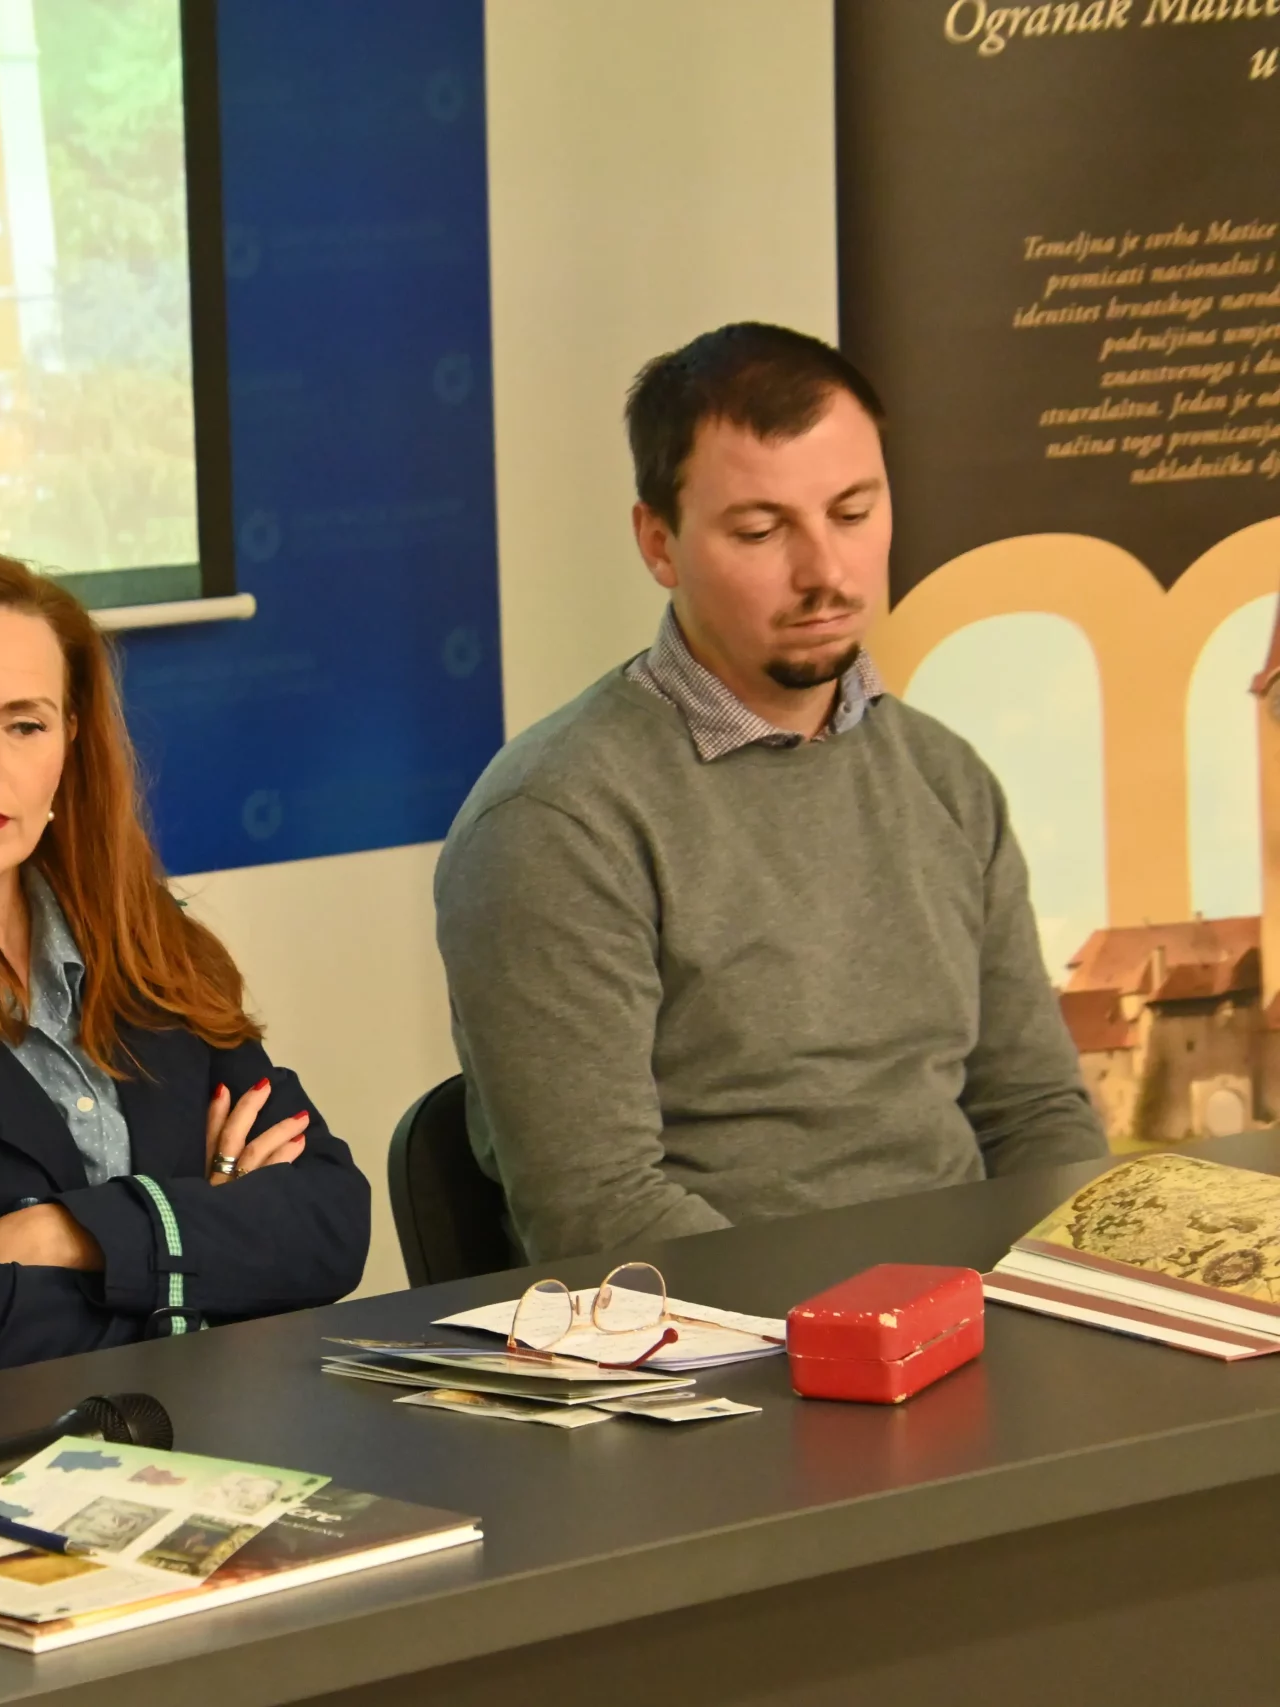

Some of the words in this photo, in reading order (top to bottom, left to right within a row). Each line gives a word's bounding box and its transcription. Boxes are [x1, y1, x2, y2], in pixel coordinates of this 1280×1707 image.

[944, 0, 1131, 57] Ogranak
[1249, 46, 1280, 80] u
[1023, 230, 1116, 262] Temeljna
[1117, 228, 1141, 258] je
[1144, 222, 1201, 251] svrha
[1203, 218, 1278, 245] Matice
[1042, 262, 1147, 300] promicati
[1150, 252, 1261, 283] nacionalni
[1263, 253, 1275, 274] i
[1012, 303, 1103, 329] identitet
[1105, 291, 1214, 322] hrvatskoga
[1097, 326, 1219, 363] područjima
[1099, 359, 1236, 388] znanstvenoga
[1239, 354, 1251, 376] i
[1167, 388, 1228, 422] Jedan
[1228, 387, 1253, 418] je
[1045, 434, 1116, 458] načina
[1121, 432, 1164, 458] toga
[1130, 452, 1255, 485] nakladnička
